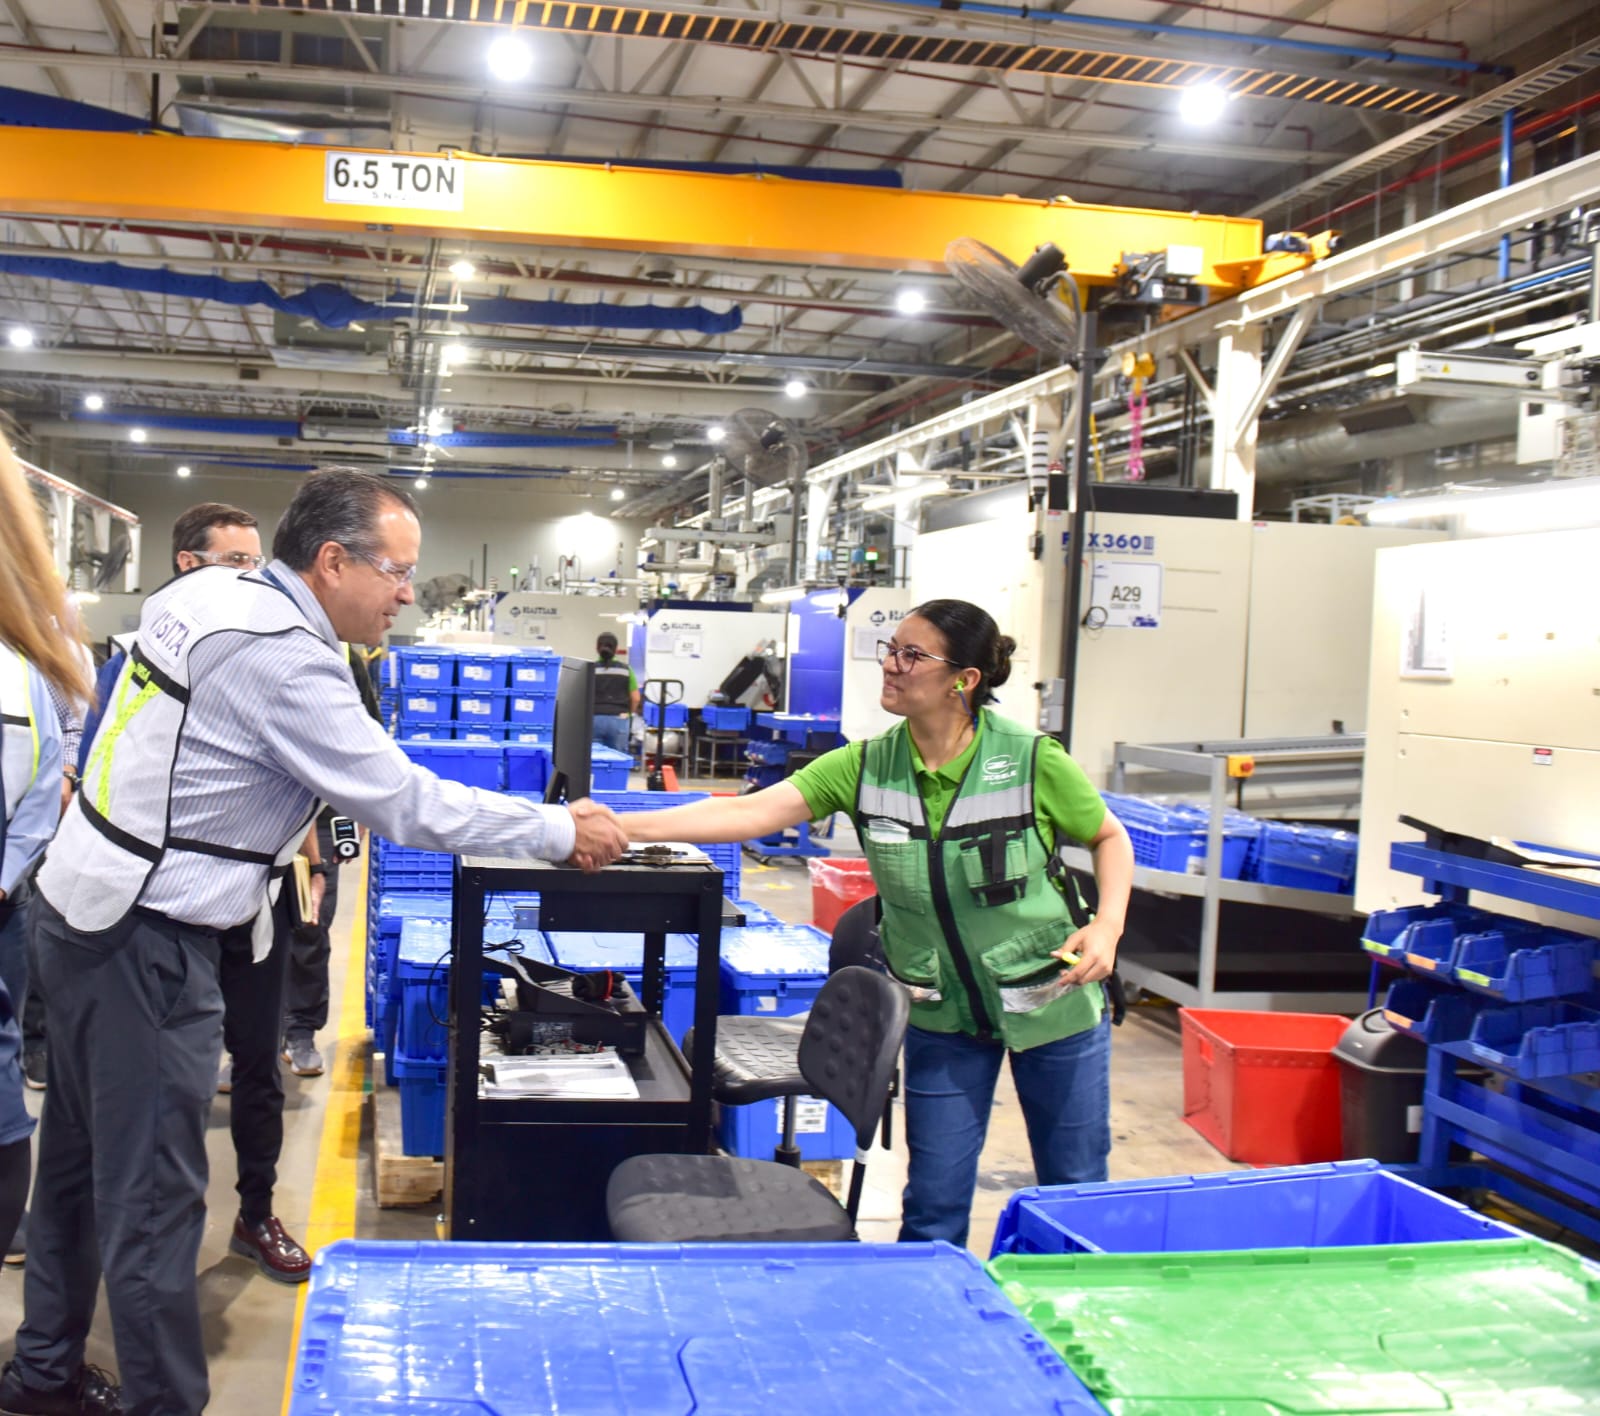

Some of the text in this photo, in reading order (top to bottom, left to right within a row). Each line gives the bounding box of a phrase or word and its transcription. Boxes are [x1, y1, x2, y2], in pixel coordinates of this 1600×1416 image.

[334, 157, 455, 194] 6.5 TON
[1111, 585, 1142, 602] A29
